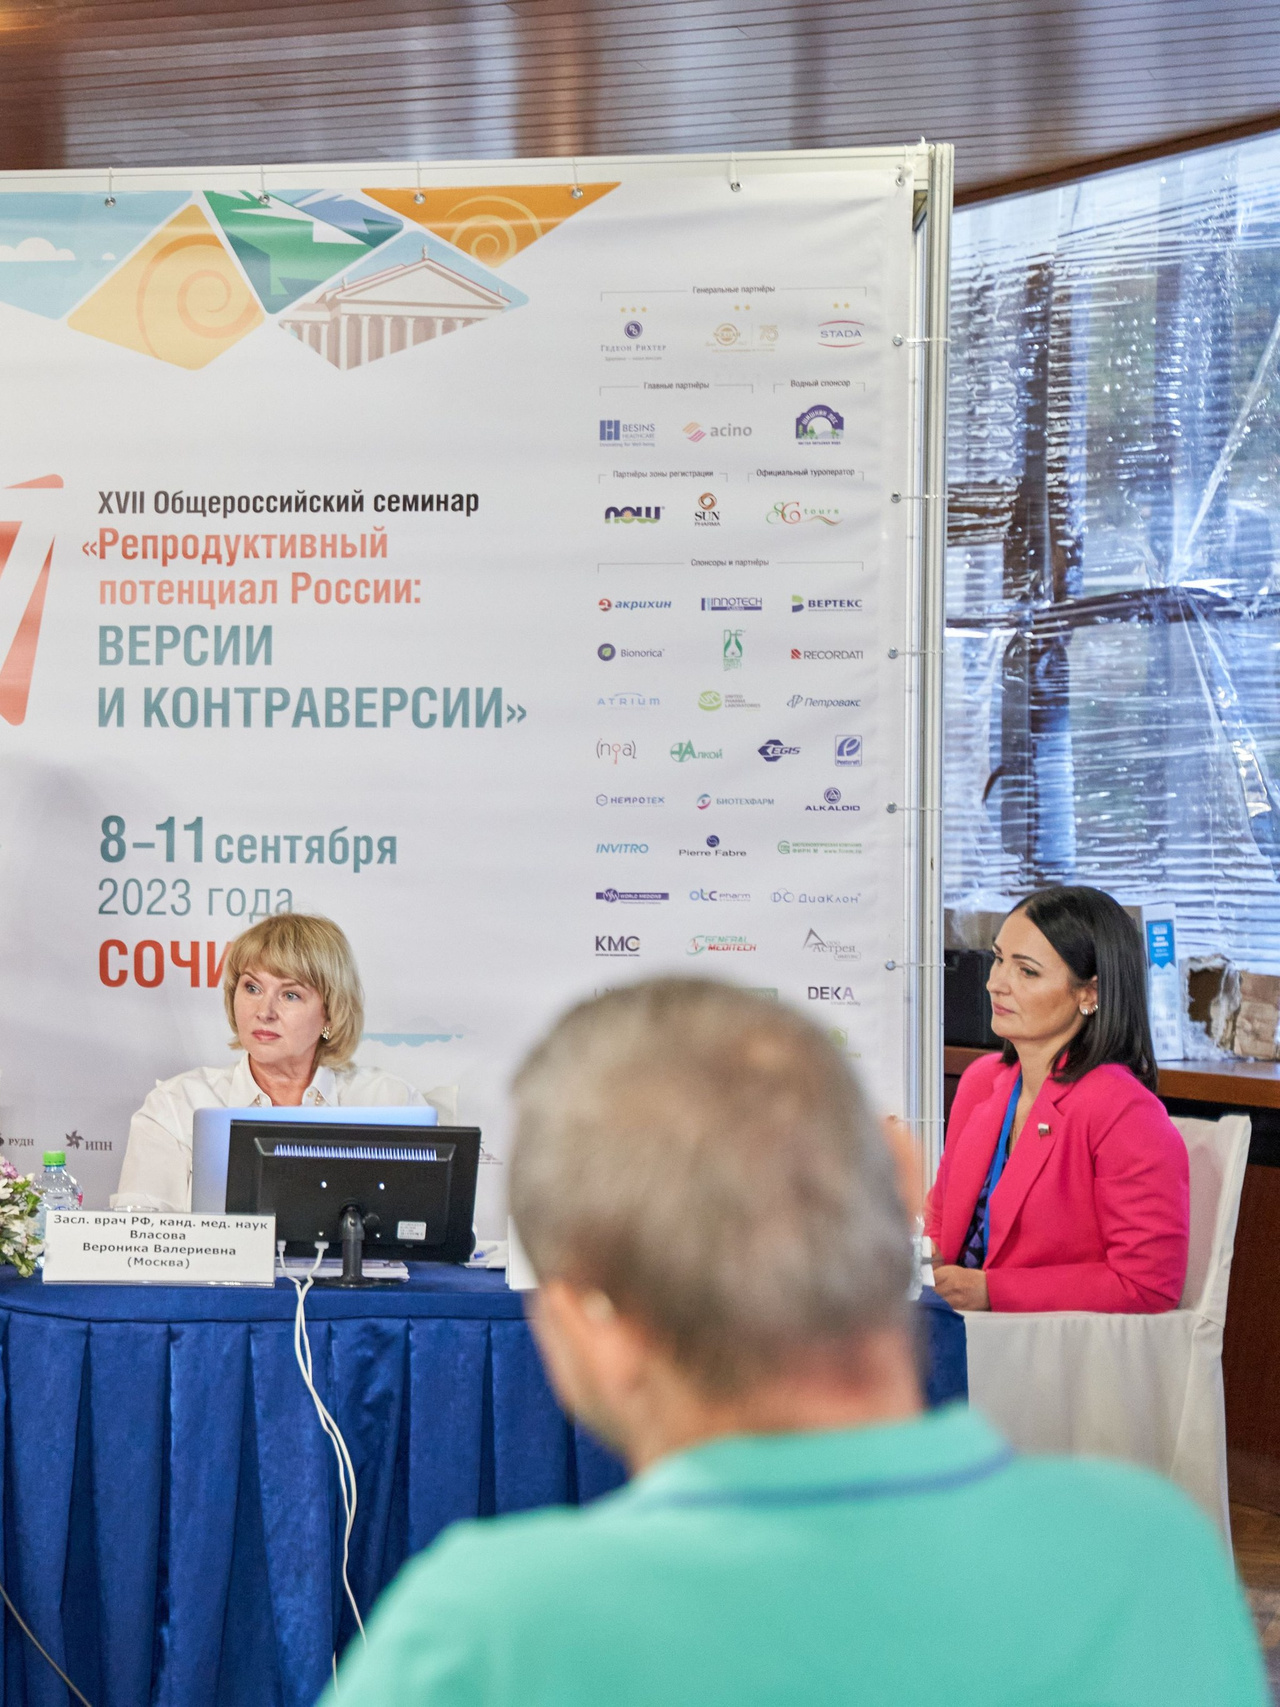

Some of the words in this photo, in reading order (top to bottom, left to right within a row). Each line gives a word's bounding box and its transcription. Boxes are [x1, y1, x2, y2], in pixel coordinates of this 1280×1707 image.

[692, 286, 739, 295] Генеральные
[741, 285, 776, 294] партнёры
[820, 329, 862, 339] STADA
[643, 381, 674, 390] Главные
[676, 381, 710, 391] партнёры
[790, 379, 819, 388] Водный
[821, 379, 851, 388] спонсор
[622, 423, 656, 433] BESINS
[710, 424, 752, 437] acino
[613, 470, 648, 479] Партнёры
[669, 470, 714, 479] регистрации
[756, 468, 809, 478] Официальный
[810, 468, 855, 478] туроператор
[97, 491, 146, 514] XVII
[153, 489, 365, 518] Общероссийский
[372, 491, 480, 518] семинар
[694, 511, 721, 521] SUN
[82, 526, 389, 567] «Репродуктивный
[690, 558, 727, 567] Спонсоры
[735, 557, 770, 568] партнёры
[97, 576, 278, 610] потенциал
[290, 572, 422, 606] России:
[614, 600, 672, 611] акрихин
[808, 599, 863, 608] ВЕРТЕКС
[97, 625, 274, 667] ВЕРСИИ
[803, 650, 864, 660] RECORDATI
[597, 697, 661, 706] ATRIUM
[804, 697, 861, 708] Петровакс
[97, 688, 123, 729] И
[142, 686, 527, 729] КОНТРАВЕРСИИ»
[771, 746, 801, 755] EGIS
[805, 804, 861, 812] ALKALOID
[214, 826, 397, 874] сентября
[595, 843, 649, 854] INVITRO
[679, 849, 711, 857] Pierre
[715, 849, 747, 857] Fabre
[689, 888, 718, 902] otc
[96, 879, 192, 917] 2023
[208, 883, 294, 924] года
[807, 986, 855, 1000] DEKA
[8, 1138, 35, 1147] РУДН
[85, 1140, 113, 1151] ИПН
[53, 1214, 90, 1225] Засл.
[94, 1216, 127, 1227] врач
[131, 1216, 155, 1228] РФ,
[159, 1218, 197, 1230] канд.
[200, 1220, 231, 1230] мед.
[235, 1220, 269, 1231] наук
[129, 1229, 187, 1241] Власова
[82, 1242, 150, 1255] Вероника
[153, 1244, 237, 1257] Валериевна
[126, 1256, 192, 1270] (Москва)
